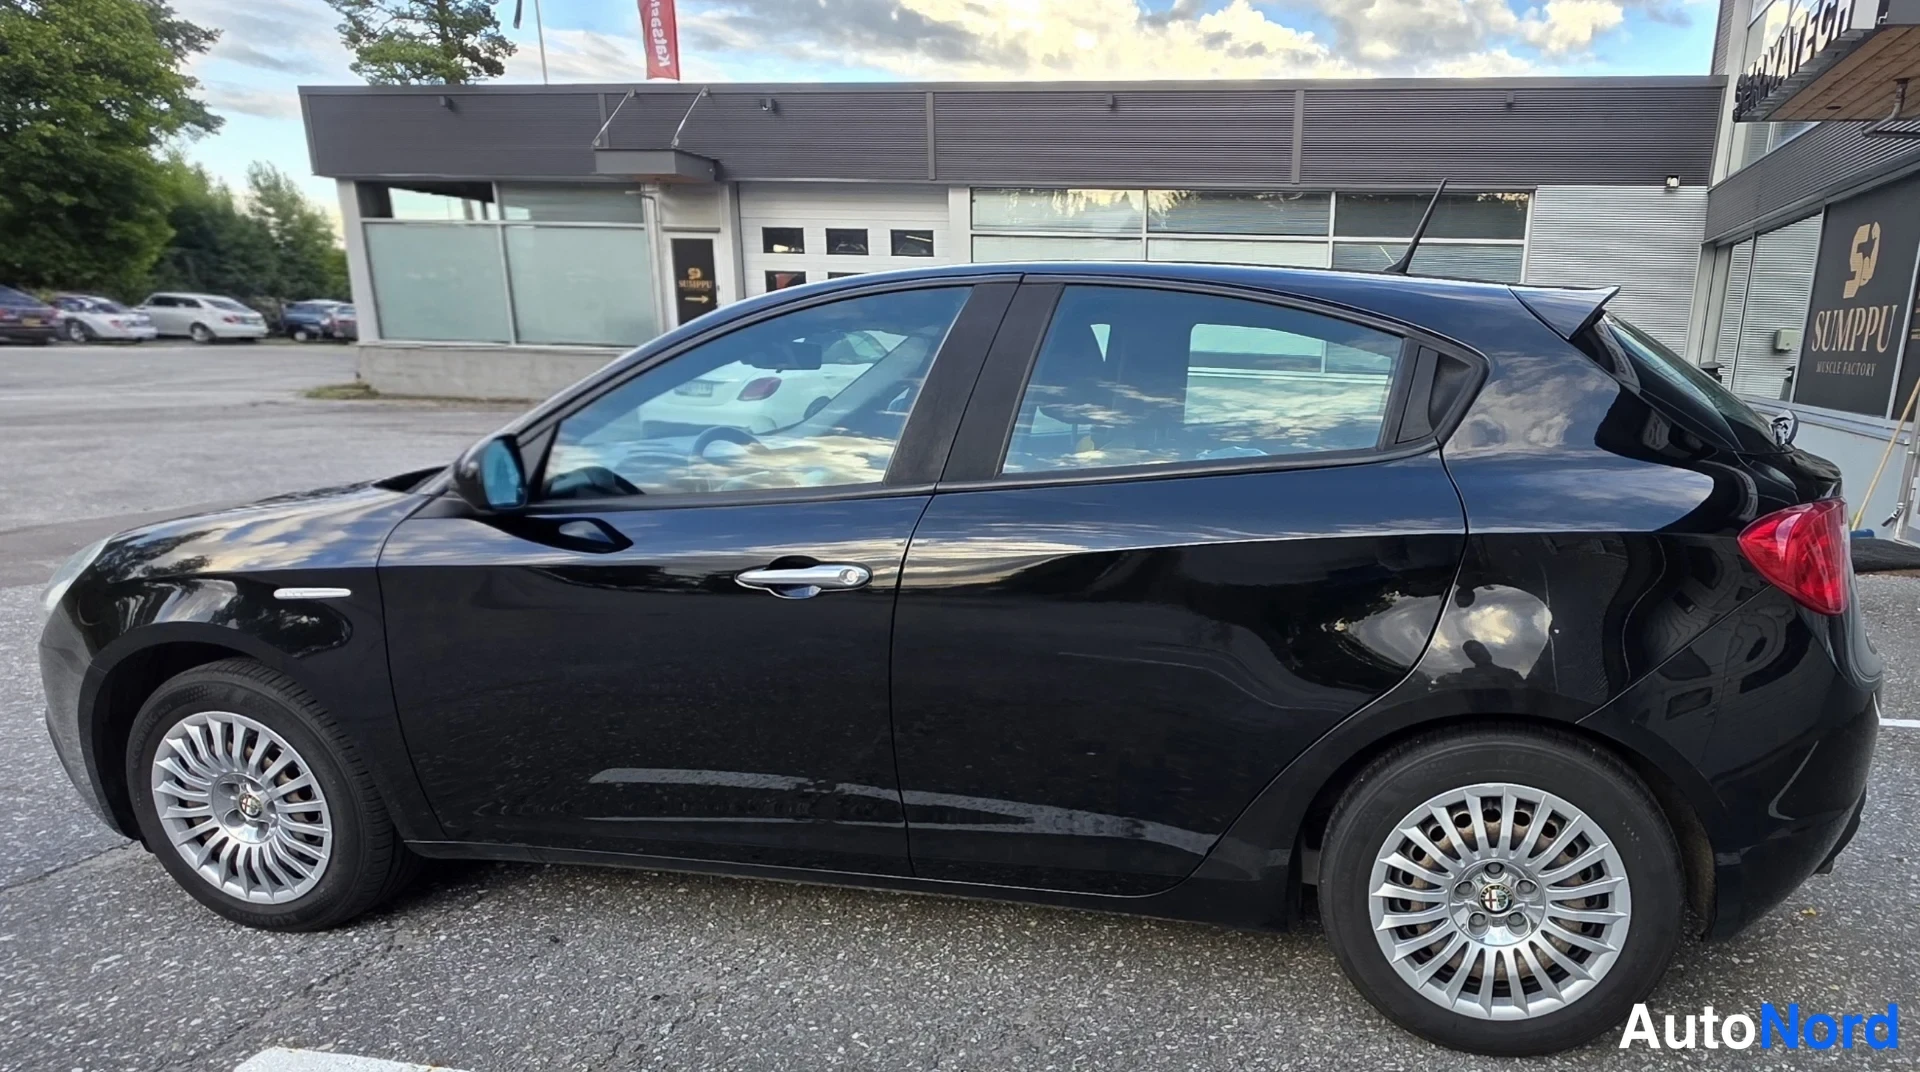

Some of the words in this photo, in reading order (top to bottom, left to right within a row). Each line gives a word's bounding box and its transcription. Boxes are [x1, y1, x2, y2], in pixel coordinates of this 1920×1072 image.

[679, 280, 712, 289] SUMPPU
[1812, 305, 1898, 353] SUMPPU
[1816, 361, 1841, 374] MUSCLE
[1842, 361, 1876, 377] FACTORY
